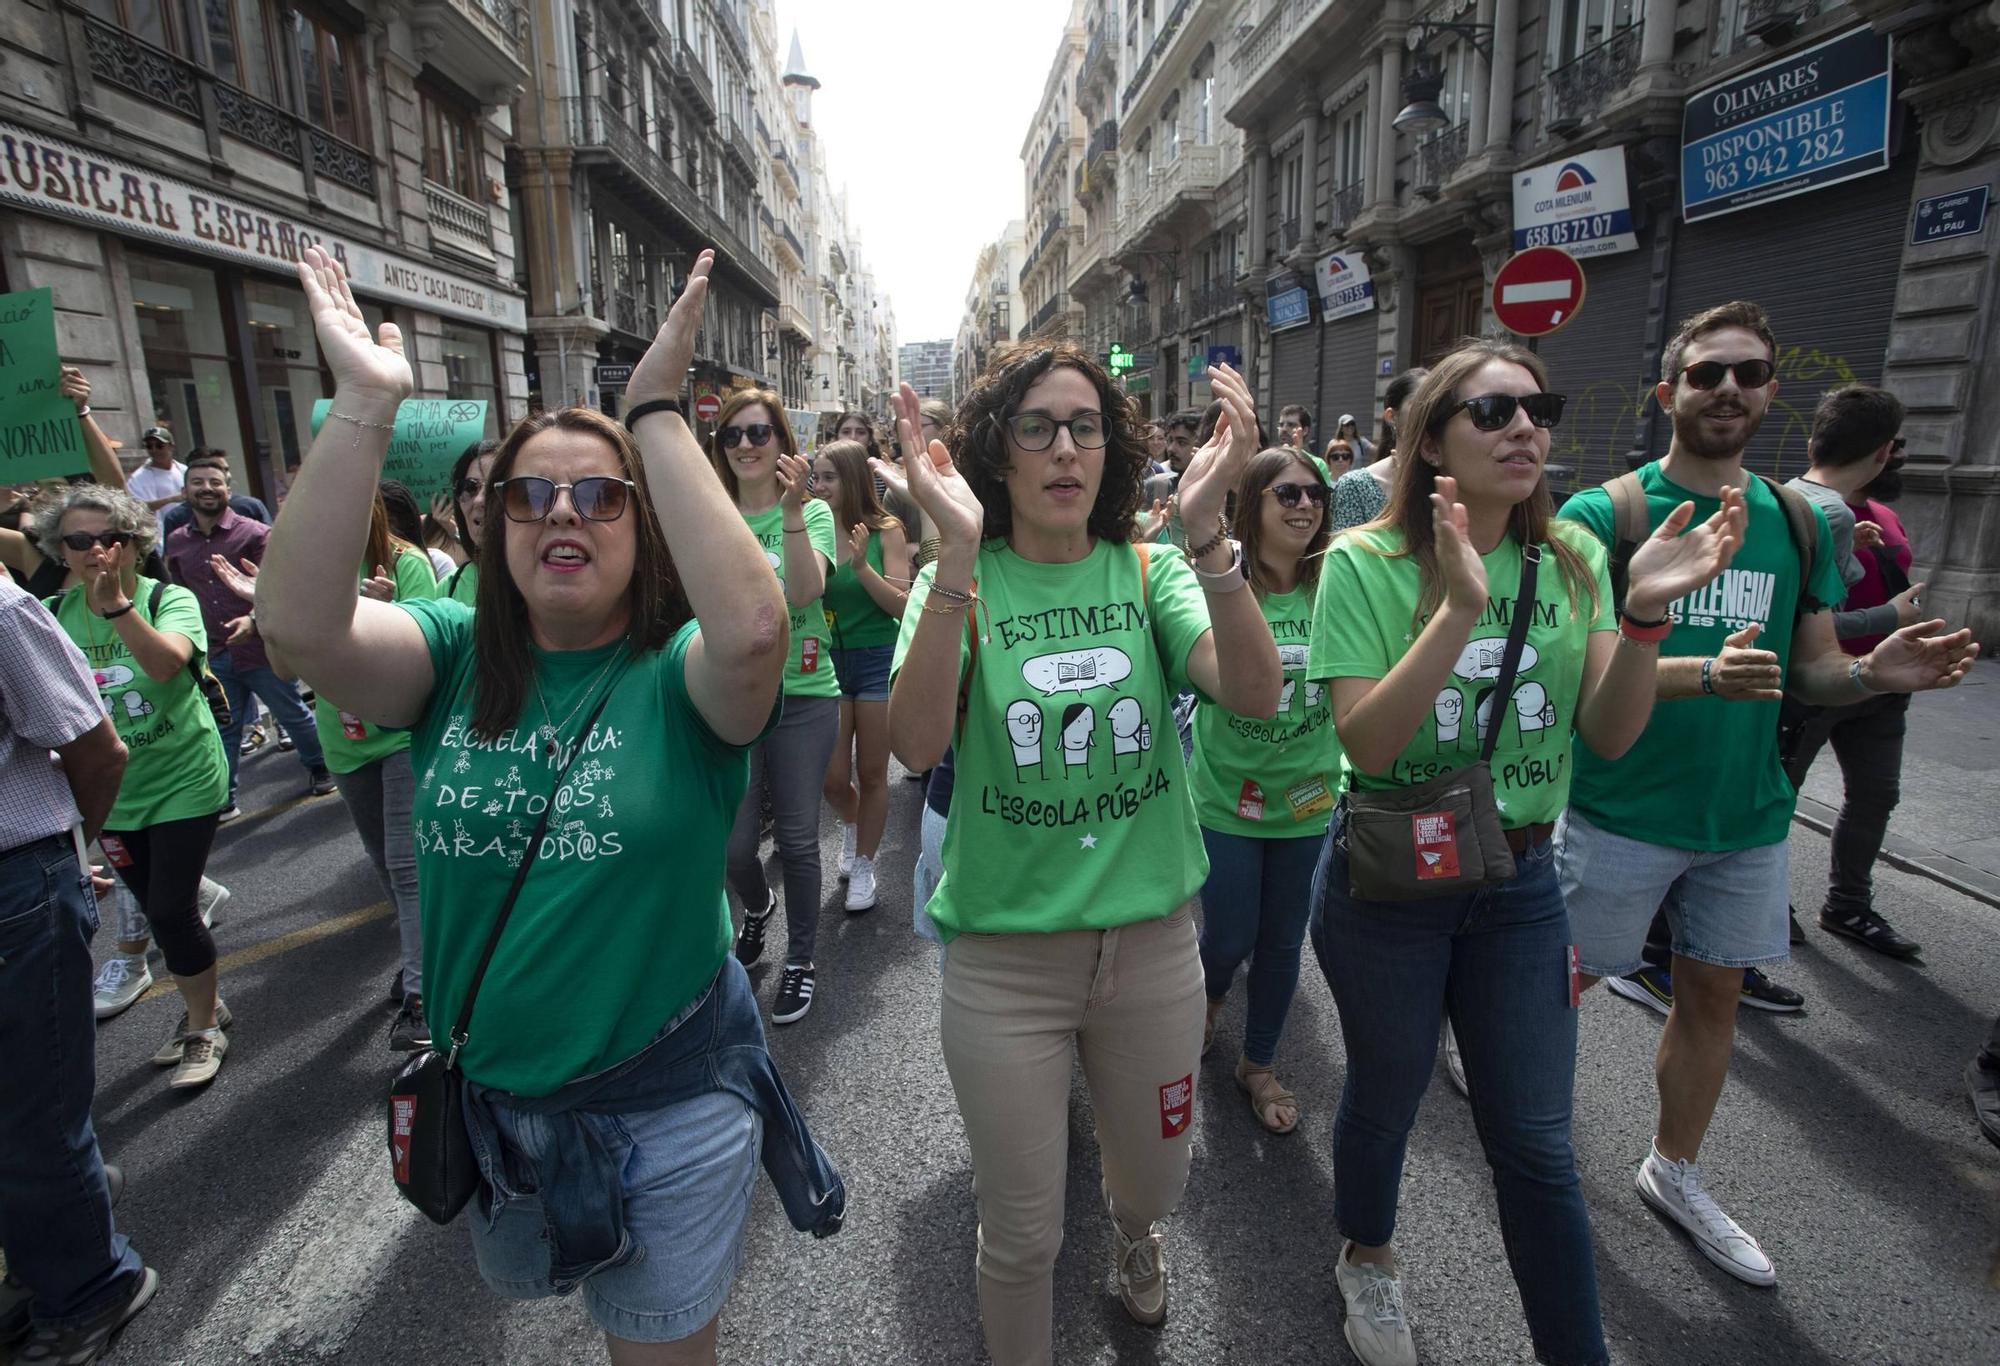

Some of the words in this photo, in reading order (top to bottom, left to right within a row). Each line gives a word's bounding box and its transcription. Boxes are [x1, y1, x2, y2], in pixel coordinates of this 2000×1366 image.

[1713, 62, 1819, 116] OLIVARES
[1703, 100, 1846, 167] DISPONIBLE
[1705, 161, 1739, 193] 963
[1745, 147, 1790, 182] 942
[1797, 128, 1845, 167] 282
[0, 134, 180, 231] USICAL
[188, 194, 352, 279] ESPAÑOA
[1534, 201, 1554, 214] COTA
[1555, 191, 1592, 208] MILENIUM
[1526, 227, 1549, 248] 658
[1552, 223, 1569, 243] 05
[1572, 219, 1590, 241] 72
[1593, 214, 1612, 237] 07
[1928, 226, 1941, 235] LA
[1943, 220, 1965, 232] PAU
[384, 263, 419, 293] ANTES
[1688, 568, 1776, 622] LLENGUA
[1689, 616, 1715, 627] ES
[1722, 617, 1766, 634] TOA
[440, 727, 538, 762] ESCUELA
[436, 784, 482, 809] DE
[503, 782, 595, 815] TO@S
[983, 785, 1090, 828] L'ESCOLA
[418, 834, 508, 857] PARA
